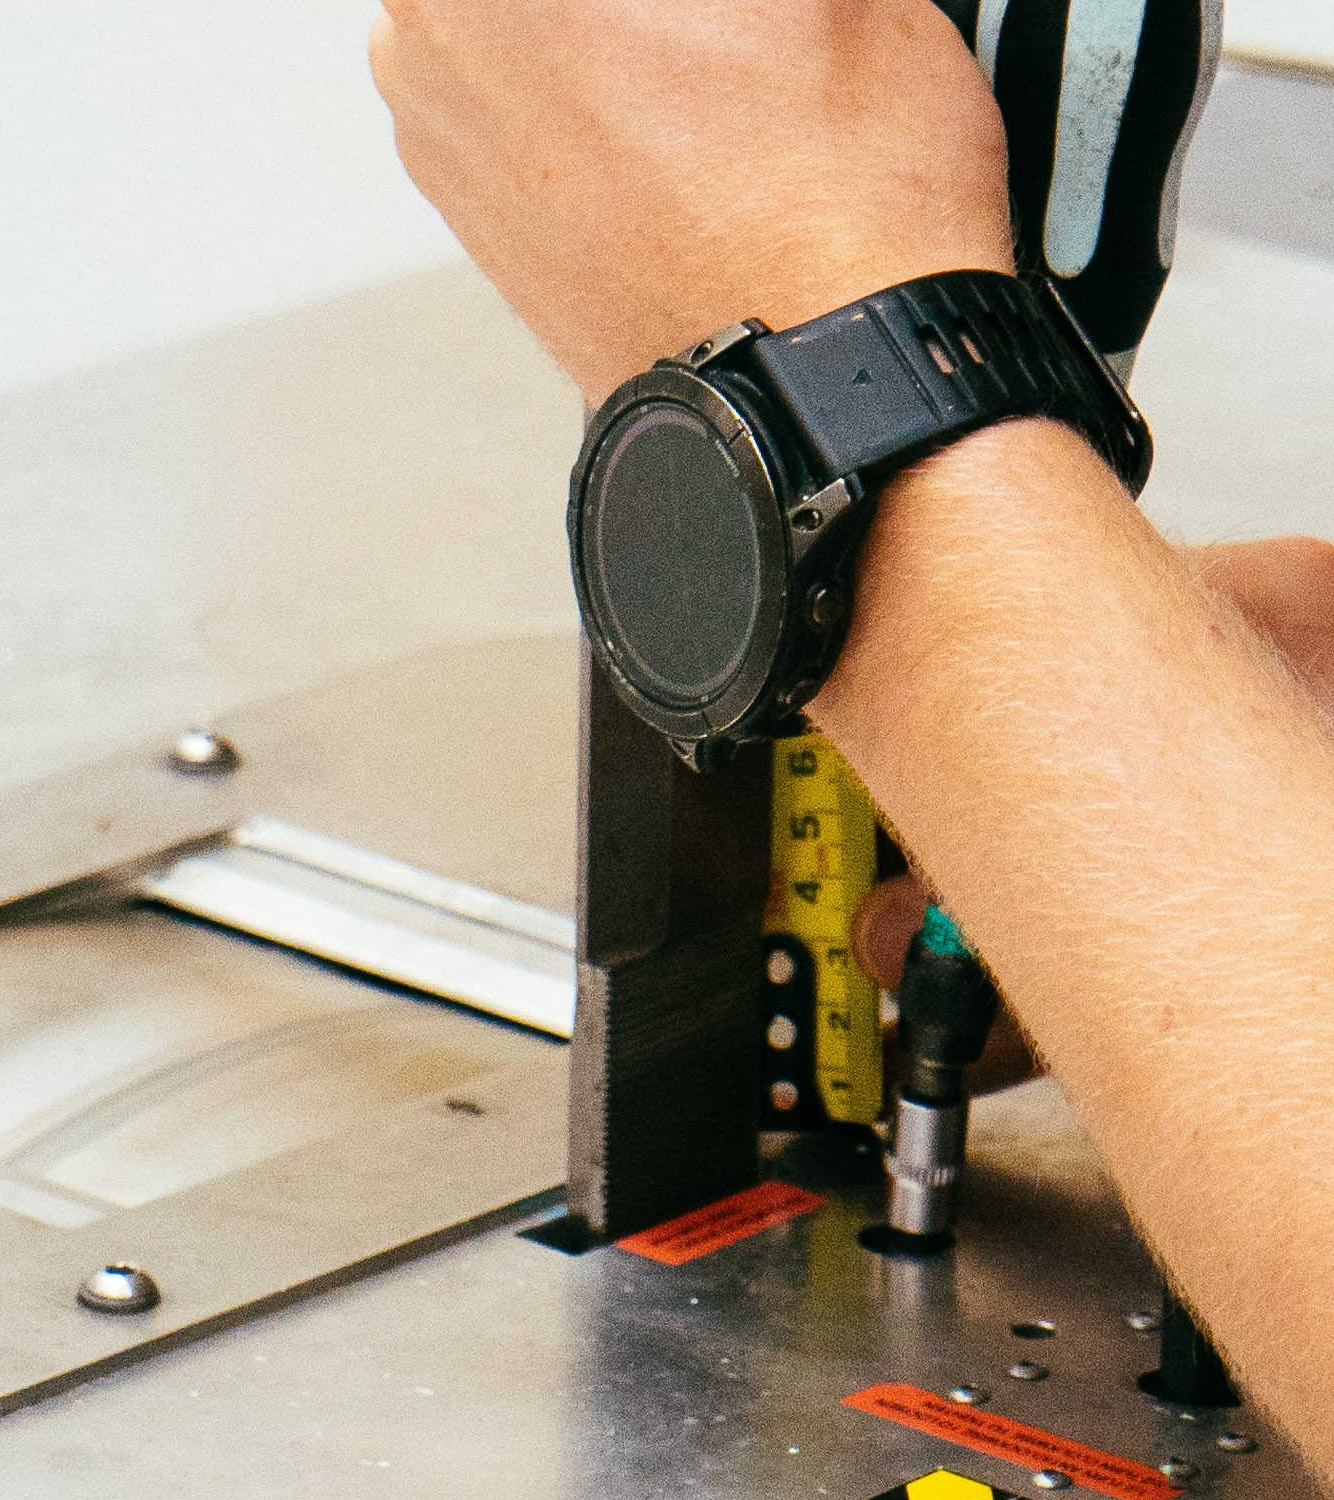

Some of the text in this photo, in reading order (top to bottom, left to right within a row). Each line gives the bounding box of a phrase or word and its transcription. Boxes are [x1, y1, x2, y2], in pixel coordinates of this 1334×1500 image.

[787, 749, 819, 777] 6
[790, 810, 821, 840] 5
[794, 880, 822, 904] 4
[827, 1009, 852, 1031] 2
